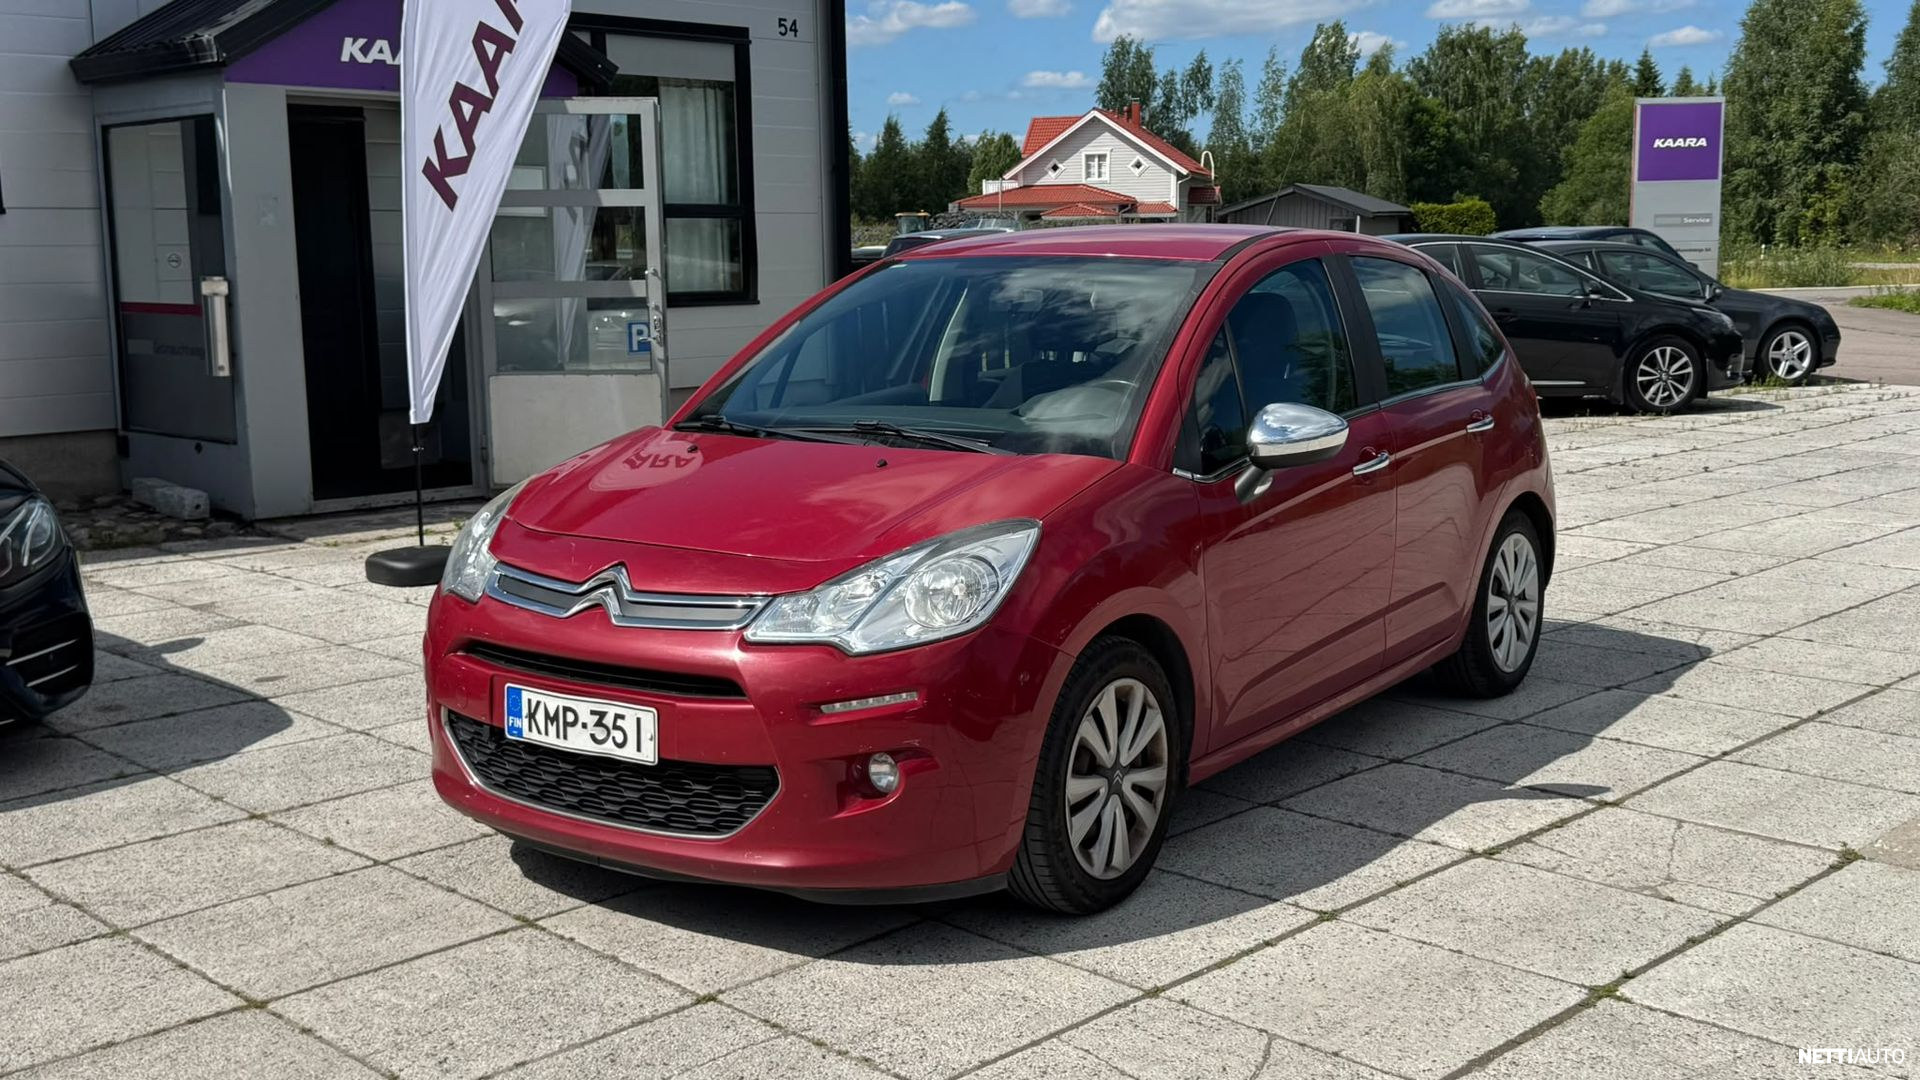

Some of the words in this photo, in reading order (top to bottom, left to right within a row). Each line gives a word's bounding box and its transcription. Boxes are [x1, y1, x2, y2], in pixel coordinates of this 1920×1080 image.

[778, 18, 798, 37] 54
[341, 37, 401, 65] KA
[1653, 137, 1707, 148] KAARA
[632, 324, 648, 350] P
[509, 716, 522, 728] FIN
[527, 698, 641, 752] KMP-351
